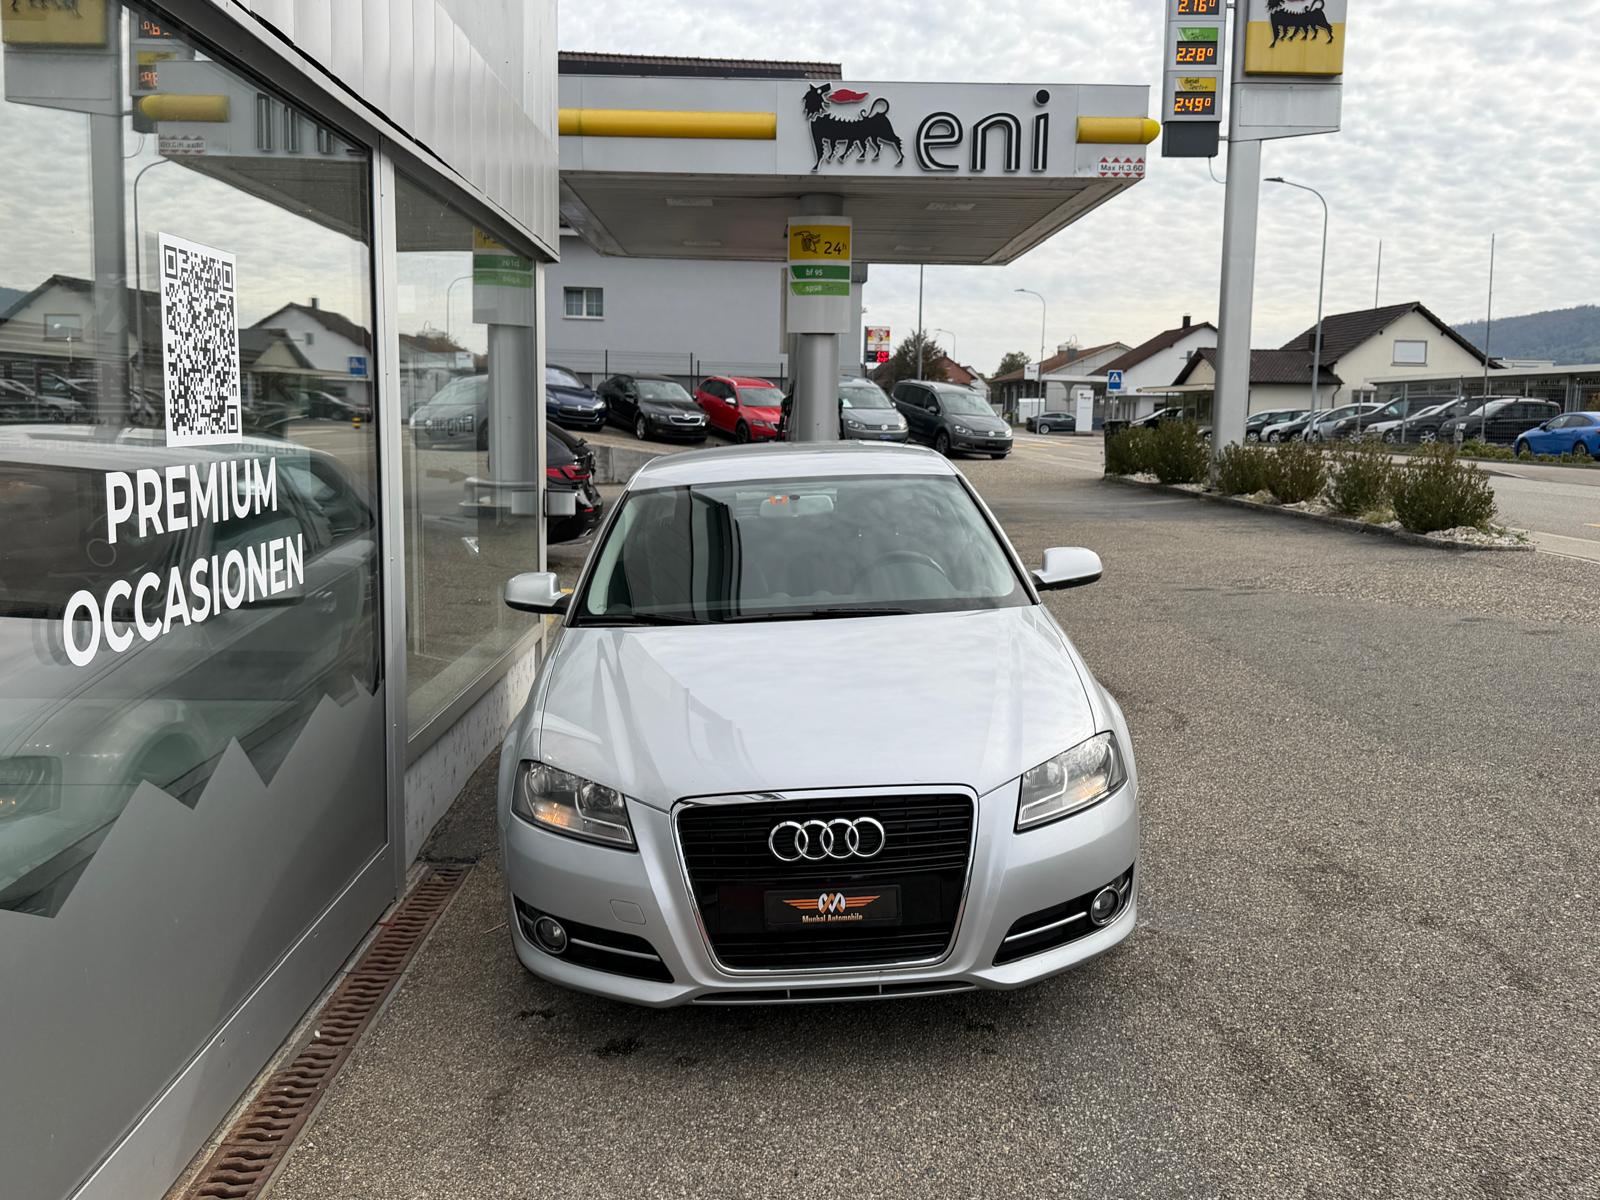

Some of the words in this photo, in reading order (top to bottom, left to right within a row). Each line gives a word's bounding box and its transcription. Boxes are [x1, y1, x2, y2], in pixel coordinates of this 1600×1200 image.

[1176, 47, 1214, 62] 2.280
[1174, 97, 1212, 112] 2.490
[914, 88, 1051, 172] eni
[1100, 163, 1116, 171] Max
[814, 268, 823, 276] 95
[105, 456, 278, 545] PREMIUM
[63, 533, 304, 667] OCCASIONEN
